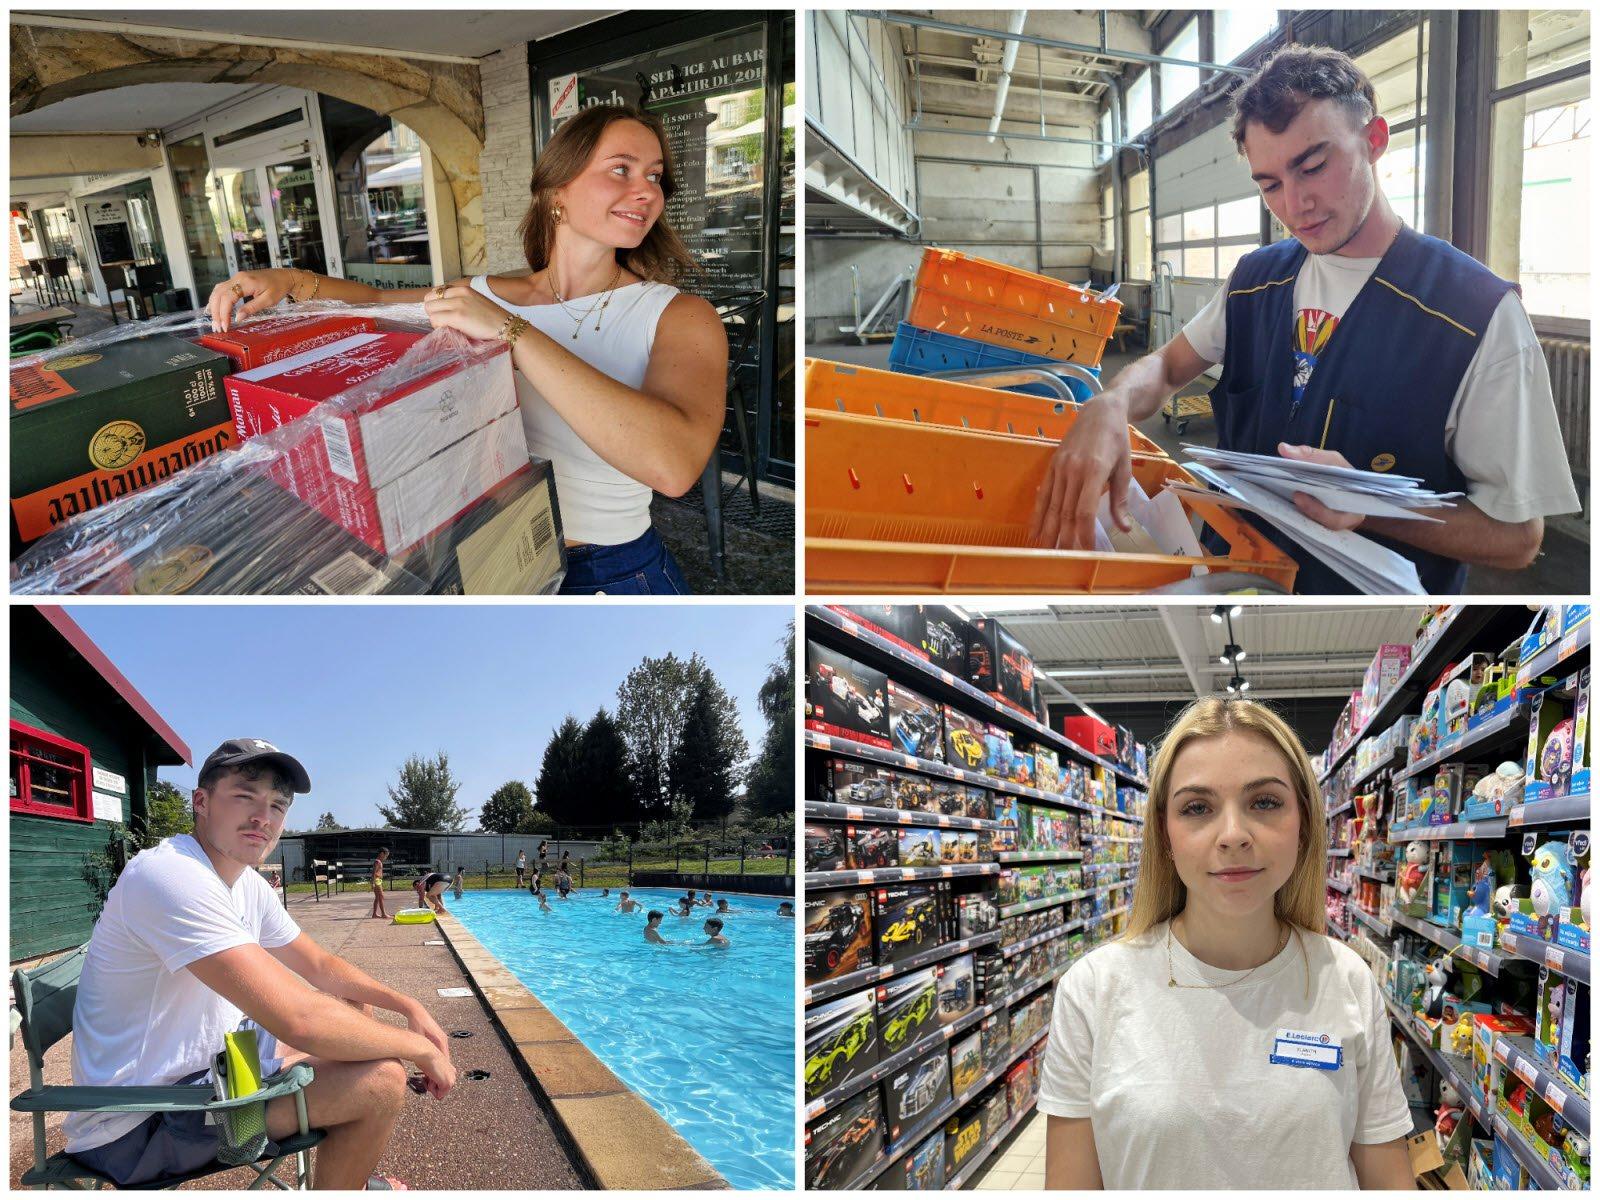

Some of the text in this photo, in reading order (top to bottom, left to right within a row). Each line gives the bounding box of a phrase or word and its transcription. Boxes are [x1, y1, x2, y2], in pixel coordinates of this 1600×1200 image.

[710, 56, 729, 71] AU
[732, 49, 766, 66] BAR
[375, 279, 394, 289] Pub
[980, 324, 1024, 341] LA POSTE
[204, 368, 213, 380] vol
[194, 370, 206, 399] 1000 ml
[813, 1113, 842, 1135] TECHNIC
